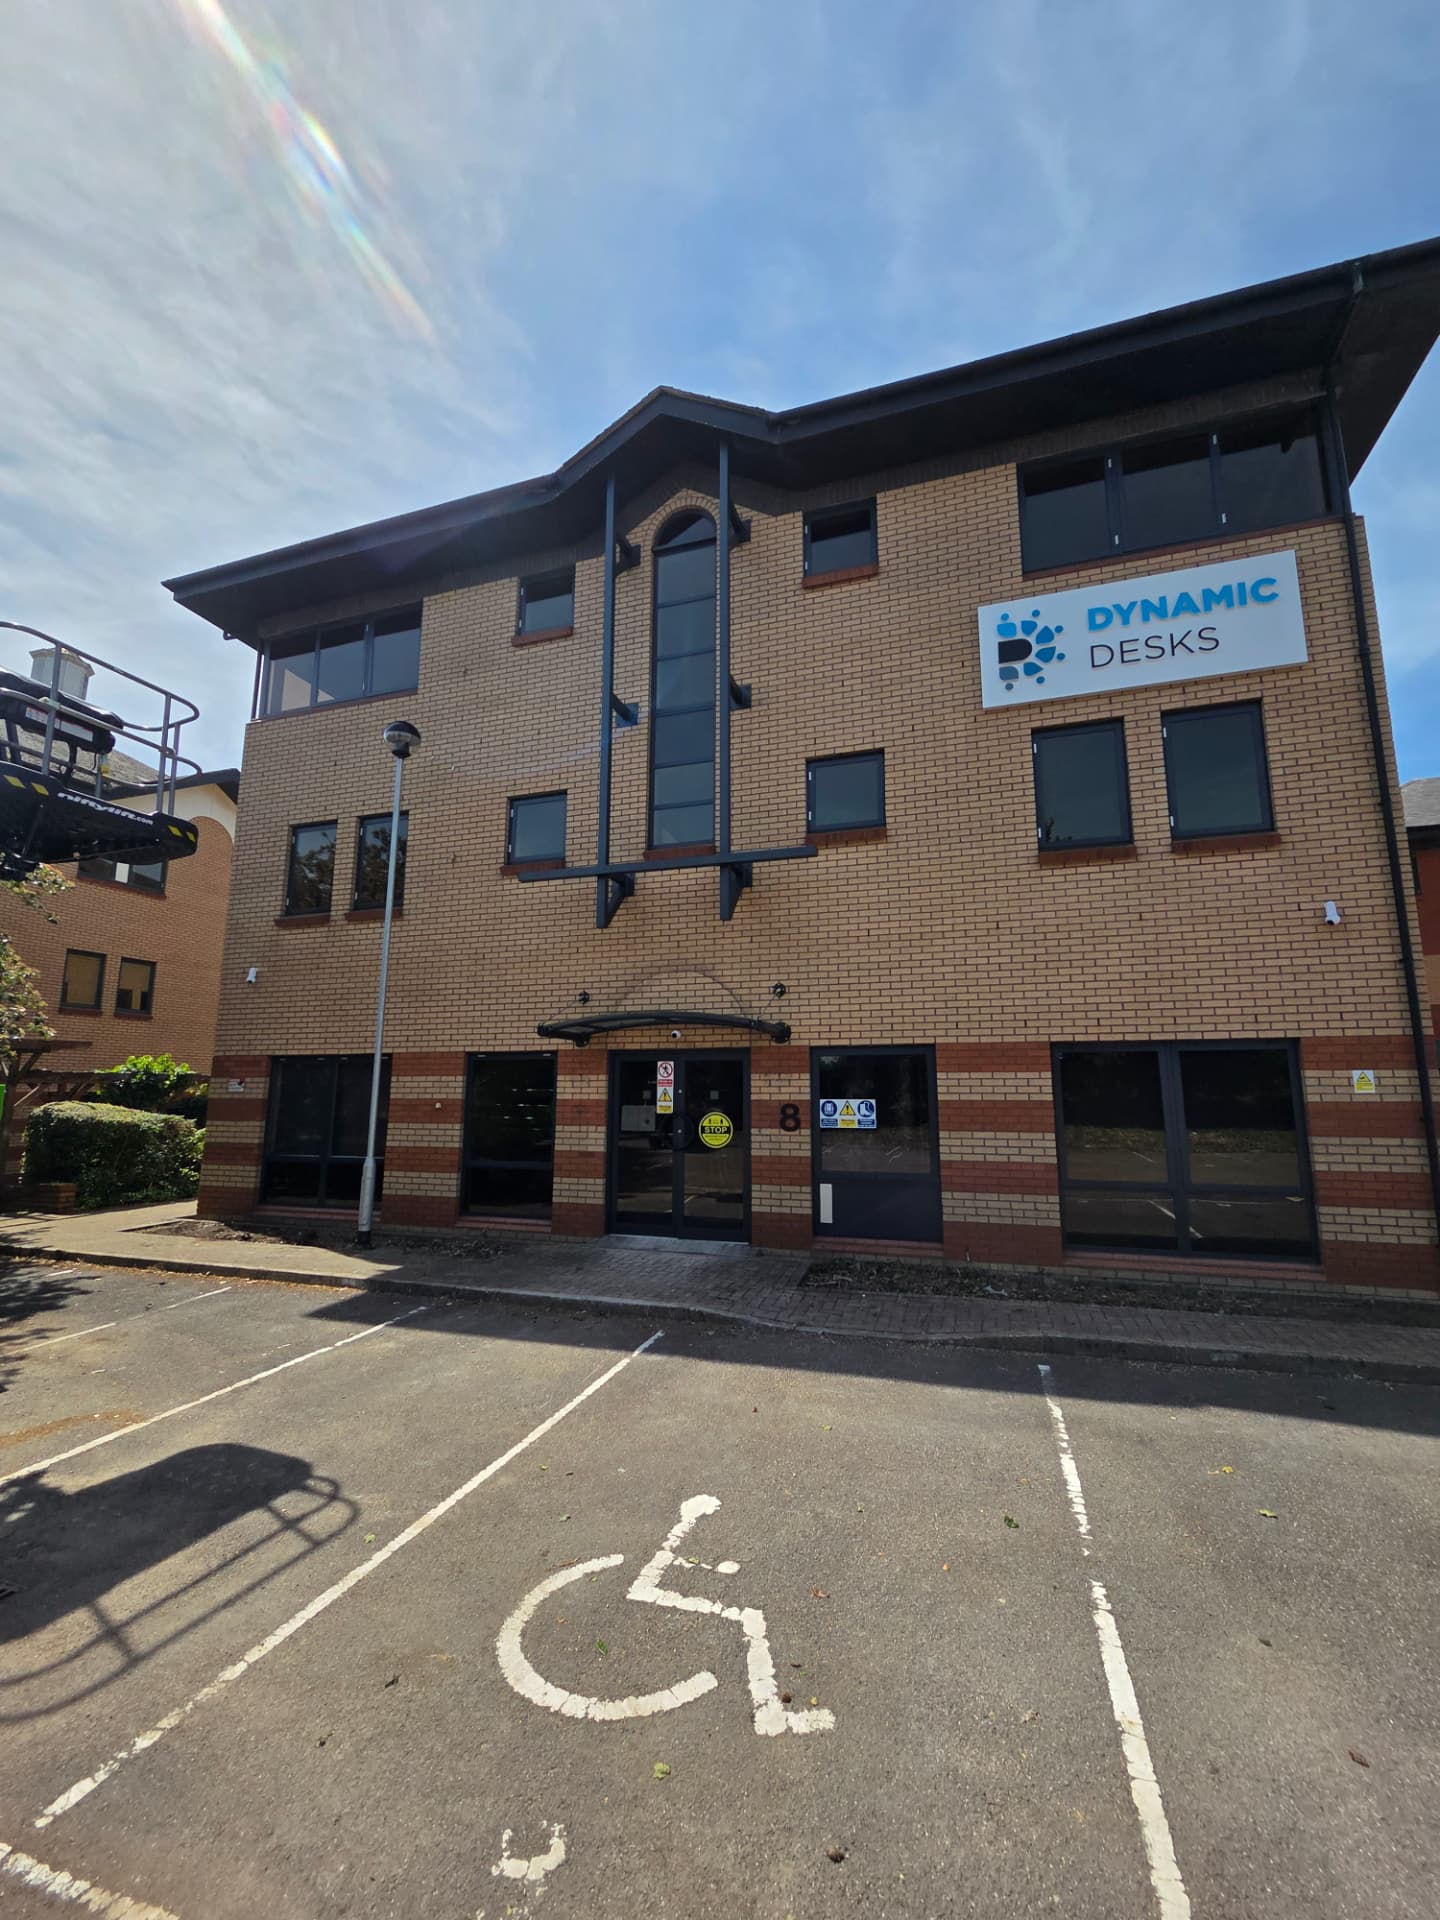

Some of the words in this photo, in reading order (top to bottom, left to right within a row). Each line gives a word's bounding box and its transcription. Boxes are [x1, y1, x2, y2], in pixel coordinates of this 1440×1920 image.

[1087, 577, 1279, 632] DYNAMIC
[1090, 627, 1220, 669] DESKS
[704, 1126, 728, 1134] STOP
[780, 1103, 801, 1132] 8
